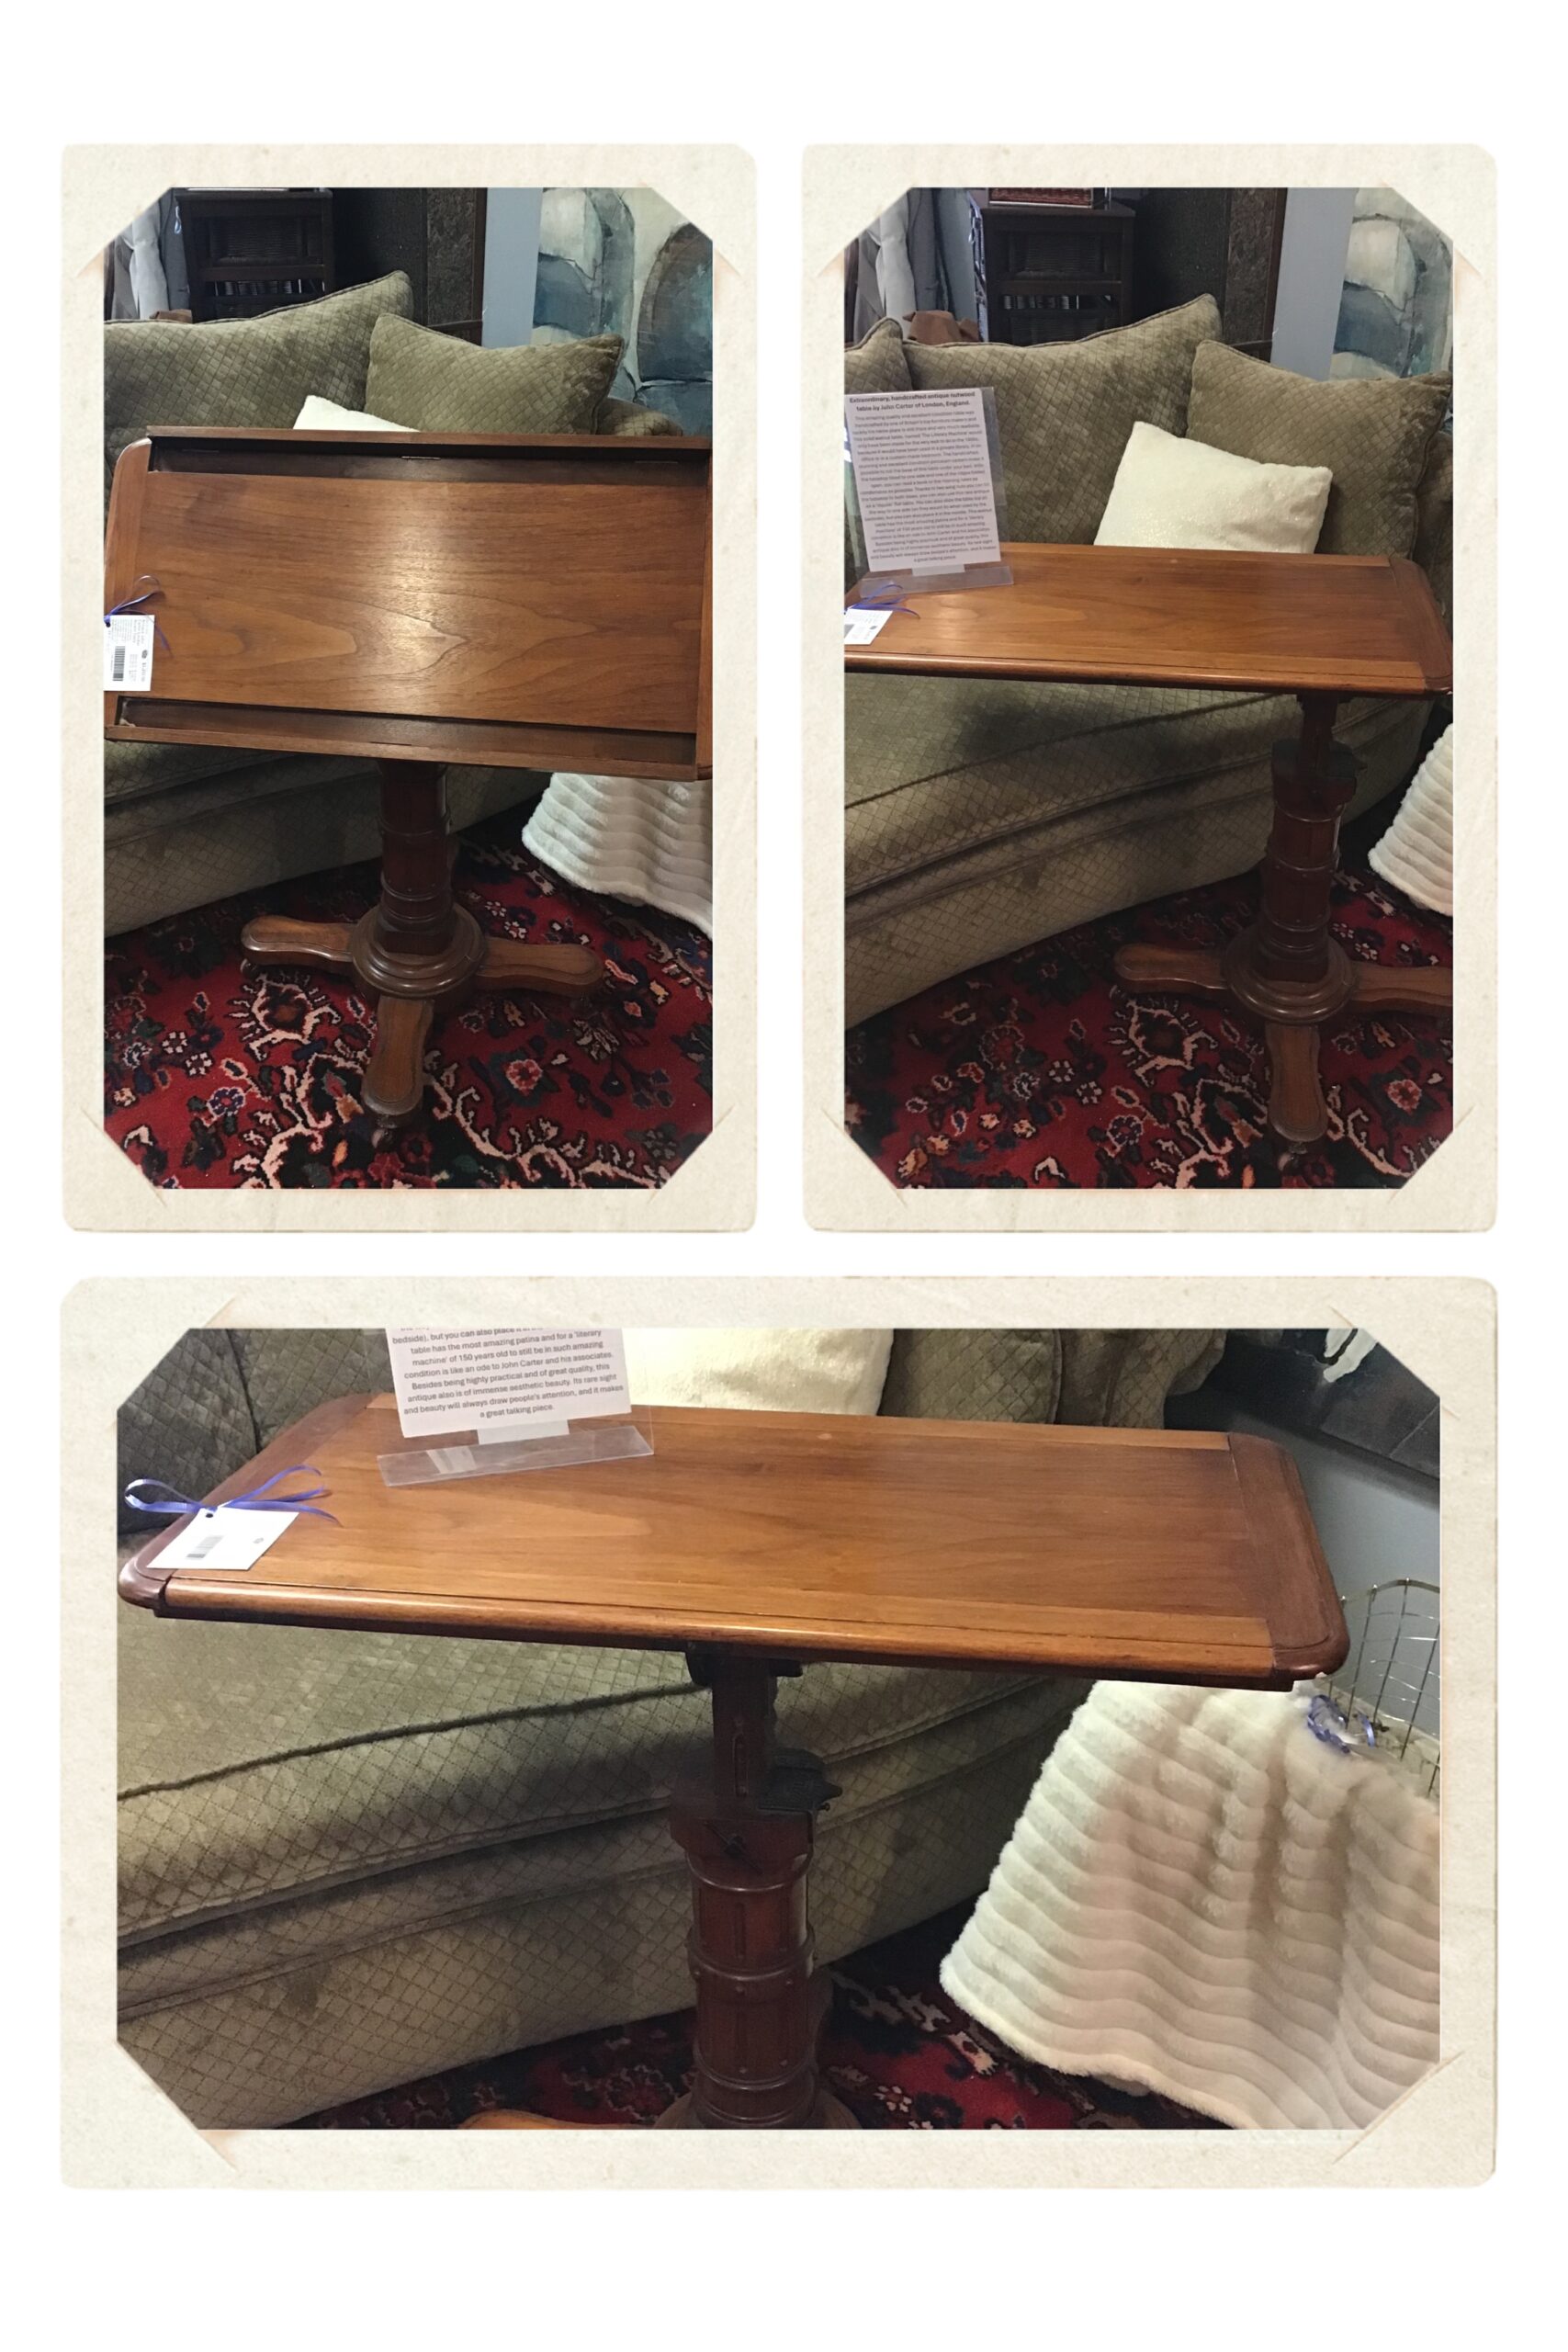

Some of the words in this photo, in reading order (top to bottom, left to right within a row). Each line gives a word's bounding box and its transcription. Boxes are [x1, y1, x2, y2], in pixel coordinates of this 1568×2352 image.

[411, 1346, 431, 1354] table
[432, 1344, 446, 1352] has
[462, 1341, 481, 1349] most
[516, 1335, 540, 1345] patina
[445, 1332, 459, 1340] you
[474, 1351, 495, 1362] years
[553, 1344, 571, 1352] such
[572, 1341, 604, 1350] amazing
[404, 1369, 440, 1379] condition
[502, 1361, 519, 1369] John
[520, 1358, 543, 1367] Carter
[573, 1351, 613, 1361] associates.
[412, 1381, 442, 1390] Besides
[444, 1379, 465, 1388] being
[466, 1376, 488, 1385] highly
[490, 1373, 523, 1381] practical
[548, 1368, 567, 1377] great
[569, 1366, 595, 1374] quality,
[408, 1394, 437, 1403] antique
[473, 1386, 508, 1395] immense
[510, 1382, 544, 1391] aesthetic
[545, 1379, 571, 1388] beauty.
[420, 1404, 446, 1413] beauty
[462, 1399, 488, 1409] always
[490, 1396, 508, 1405] draw
[510, 1393, 541, 1404] people's
[542, 1390, 577, 1399] attention,
[486, 1409, 505, 1419] great
[507, 1406, 531, 1415] talking
[532, 1404, 553, 1413] piece.
